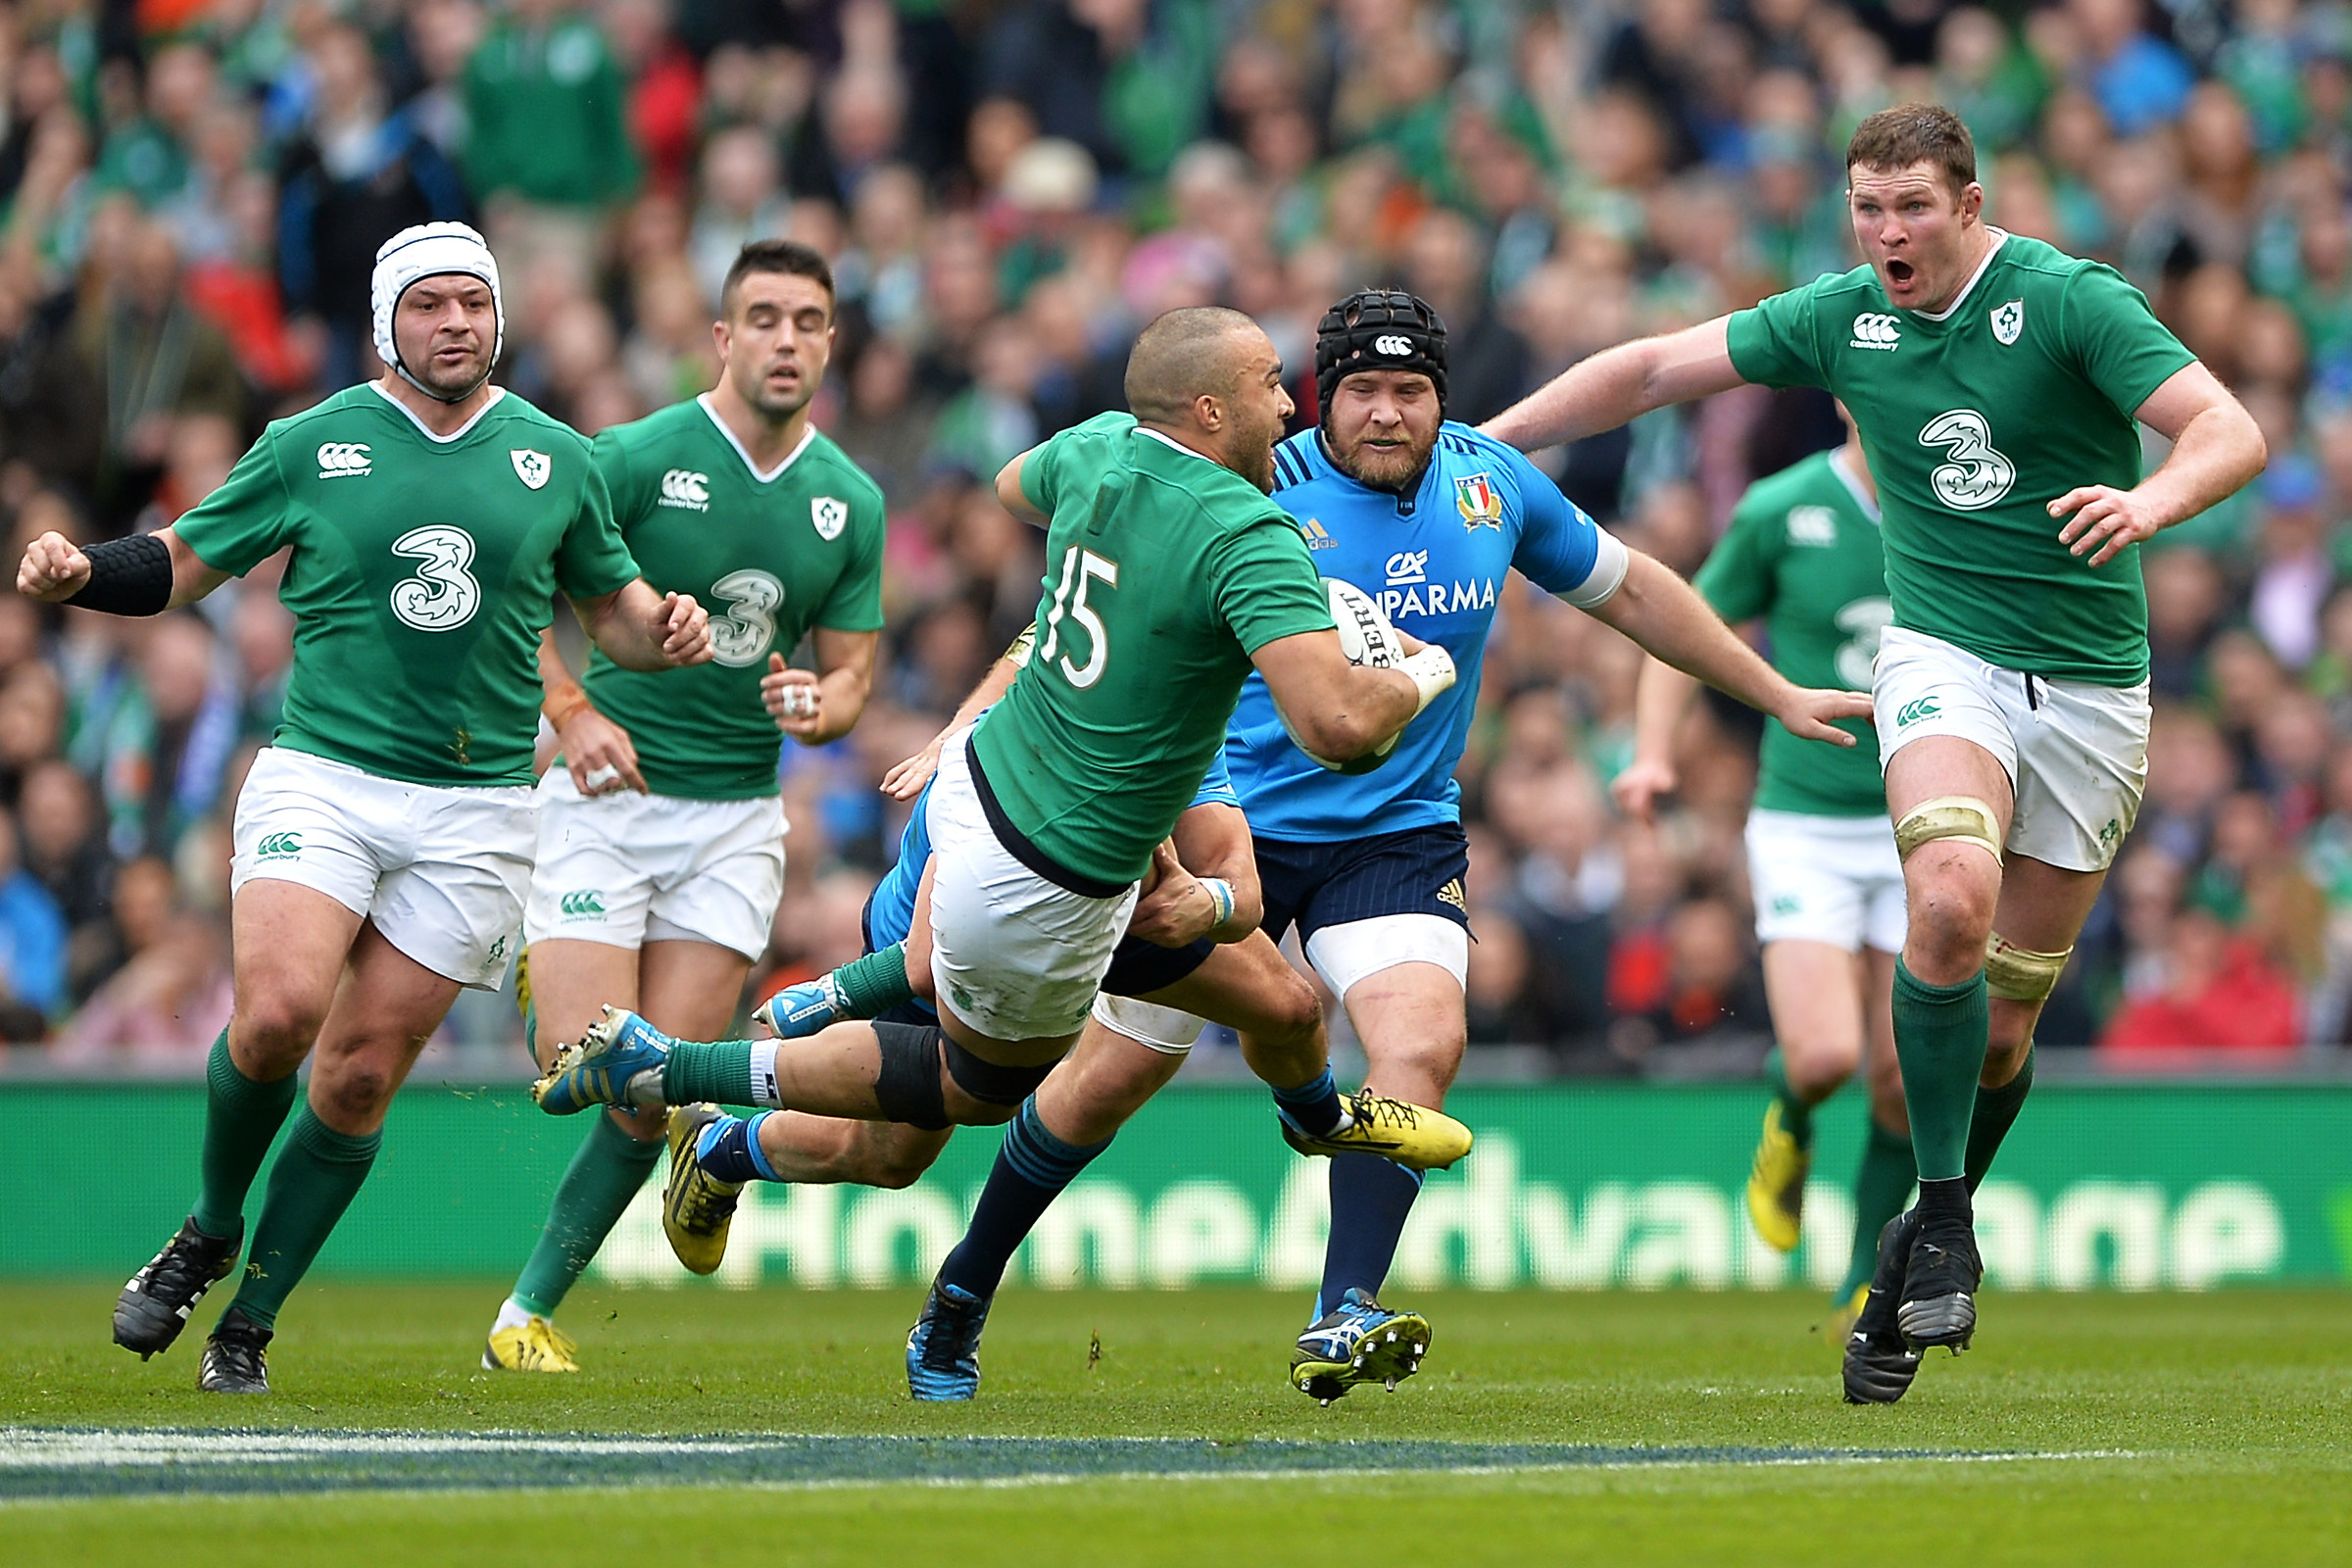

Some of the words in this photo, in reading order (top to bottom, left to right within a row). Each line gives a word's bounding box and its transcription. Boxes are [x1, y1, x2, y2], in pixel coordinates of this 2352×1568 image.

[1849, 339, 1899, 352] canterbury
[318, 467, 372, 479] canterbury
[1918, 408, 2017, 511] 3
[658, 497, 709, 513] canterbury
[390, 523, 481, 632] 3
[1375, 576, 1495, 621] IPARMA
[707, 568, 785, 667] 3
[1040, 542, 1118, 691] 15
[1339, 592, 1391, 668] BERT
